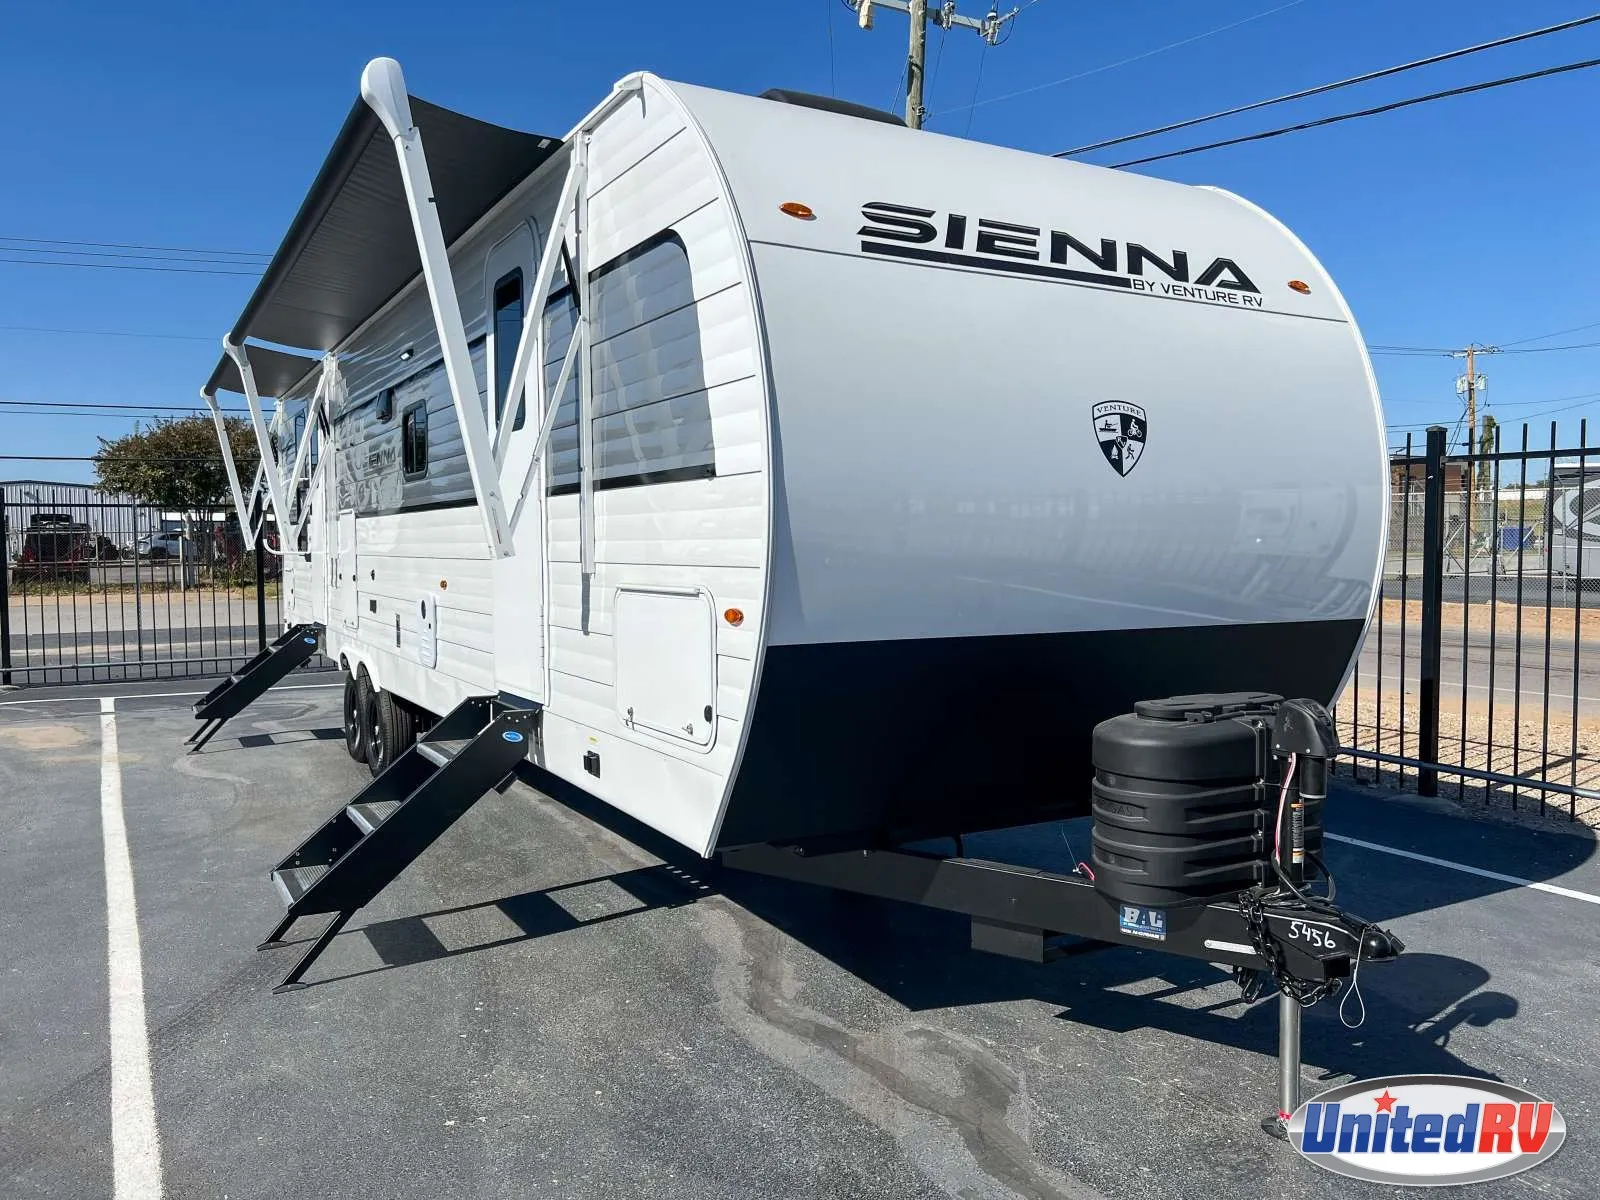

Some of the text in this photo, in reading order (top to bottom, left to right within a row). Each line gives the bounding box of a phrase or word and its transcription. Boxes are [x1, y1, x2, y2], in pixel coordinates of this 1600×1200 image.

[856, 201, 1262, 294] SIENNA
[1132, 278, 1263, 308] BY VENTURE RV
[1096, 403, 1142, 417] VENTURE
[1288, 920, 1336, 949] 5456
